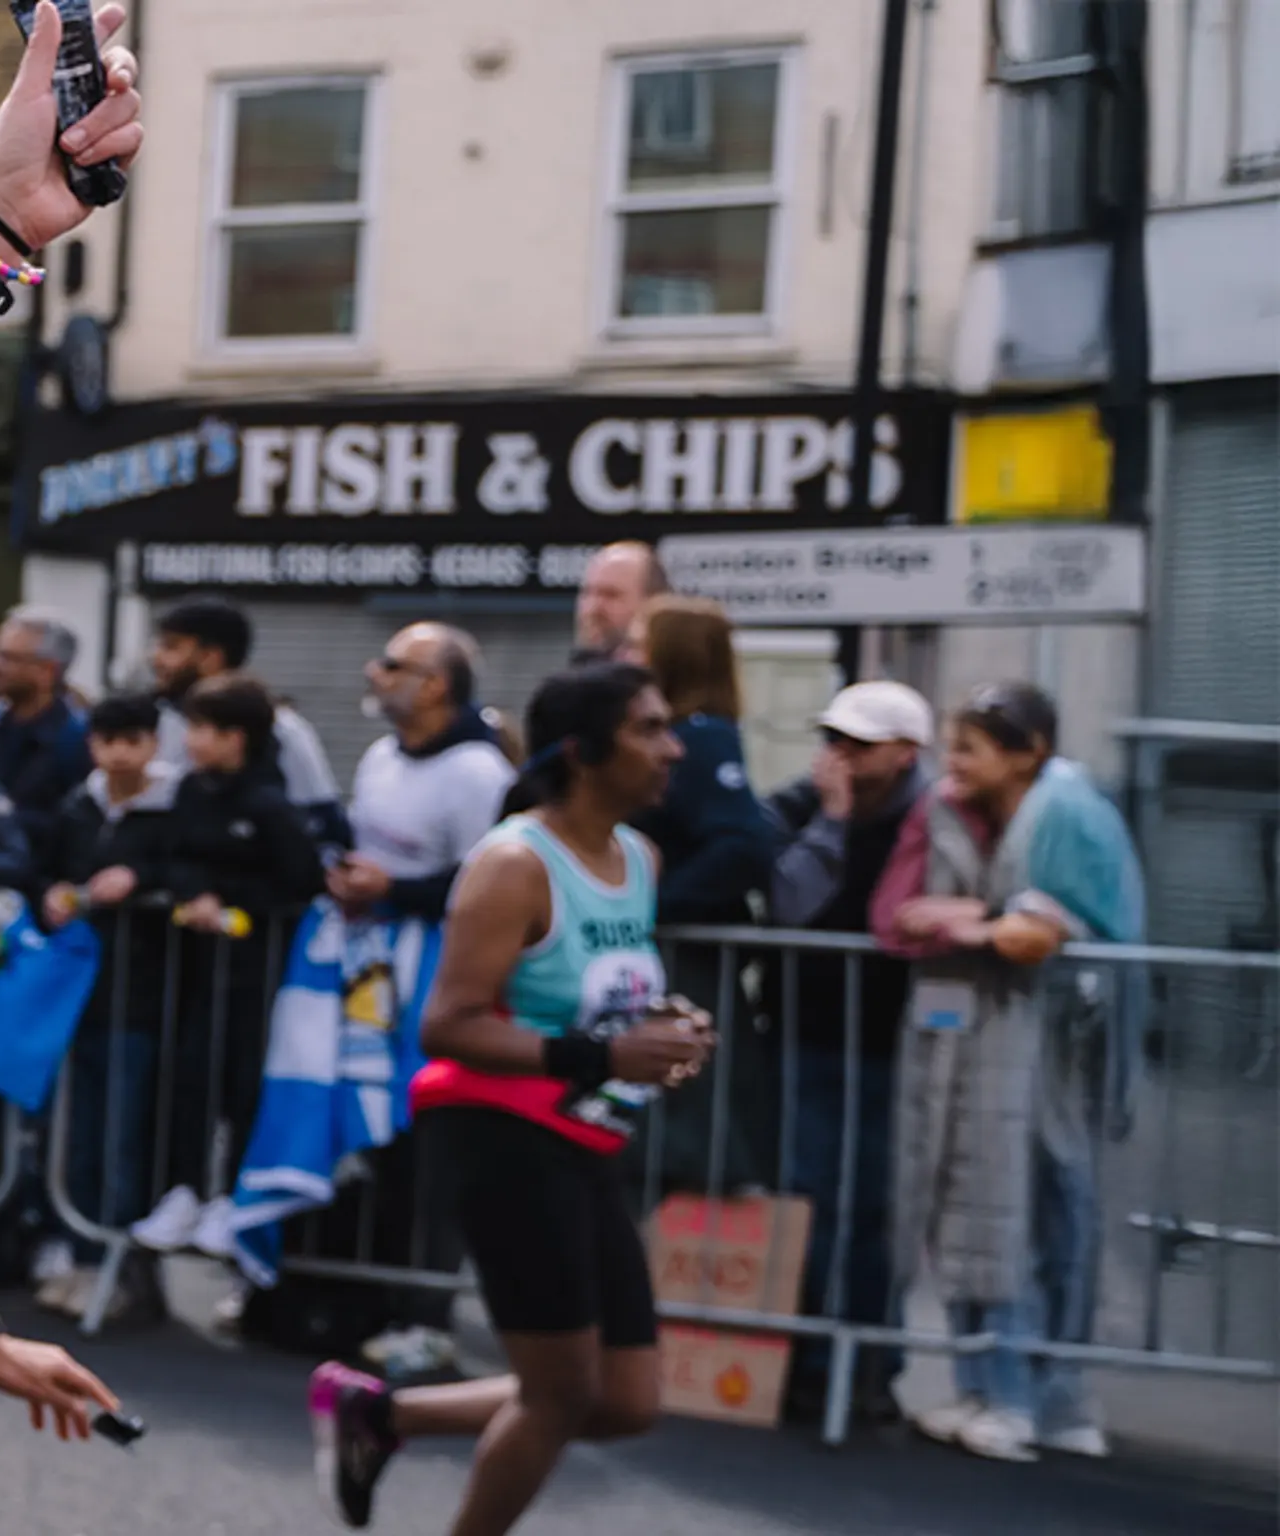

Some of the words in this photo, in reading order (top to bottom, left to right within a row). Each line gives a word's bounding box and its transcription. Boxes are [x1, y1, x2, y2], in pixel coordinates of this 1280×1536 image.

[236, 422, 458, 516] FISH
[476, 432, 551, 515] &
[814, 542, 932, 581] Bridge
